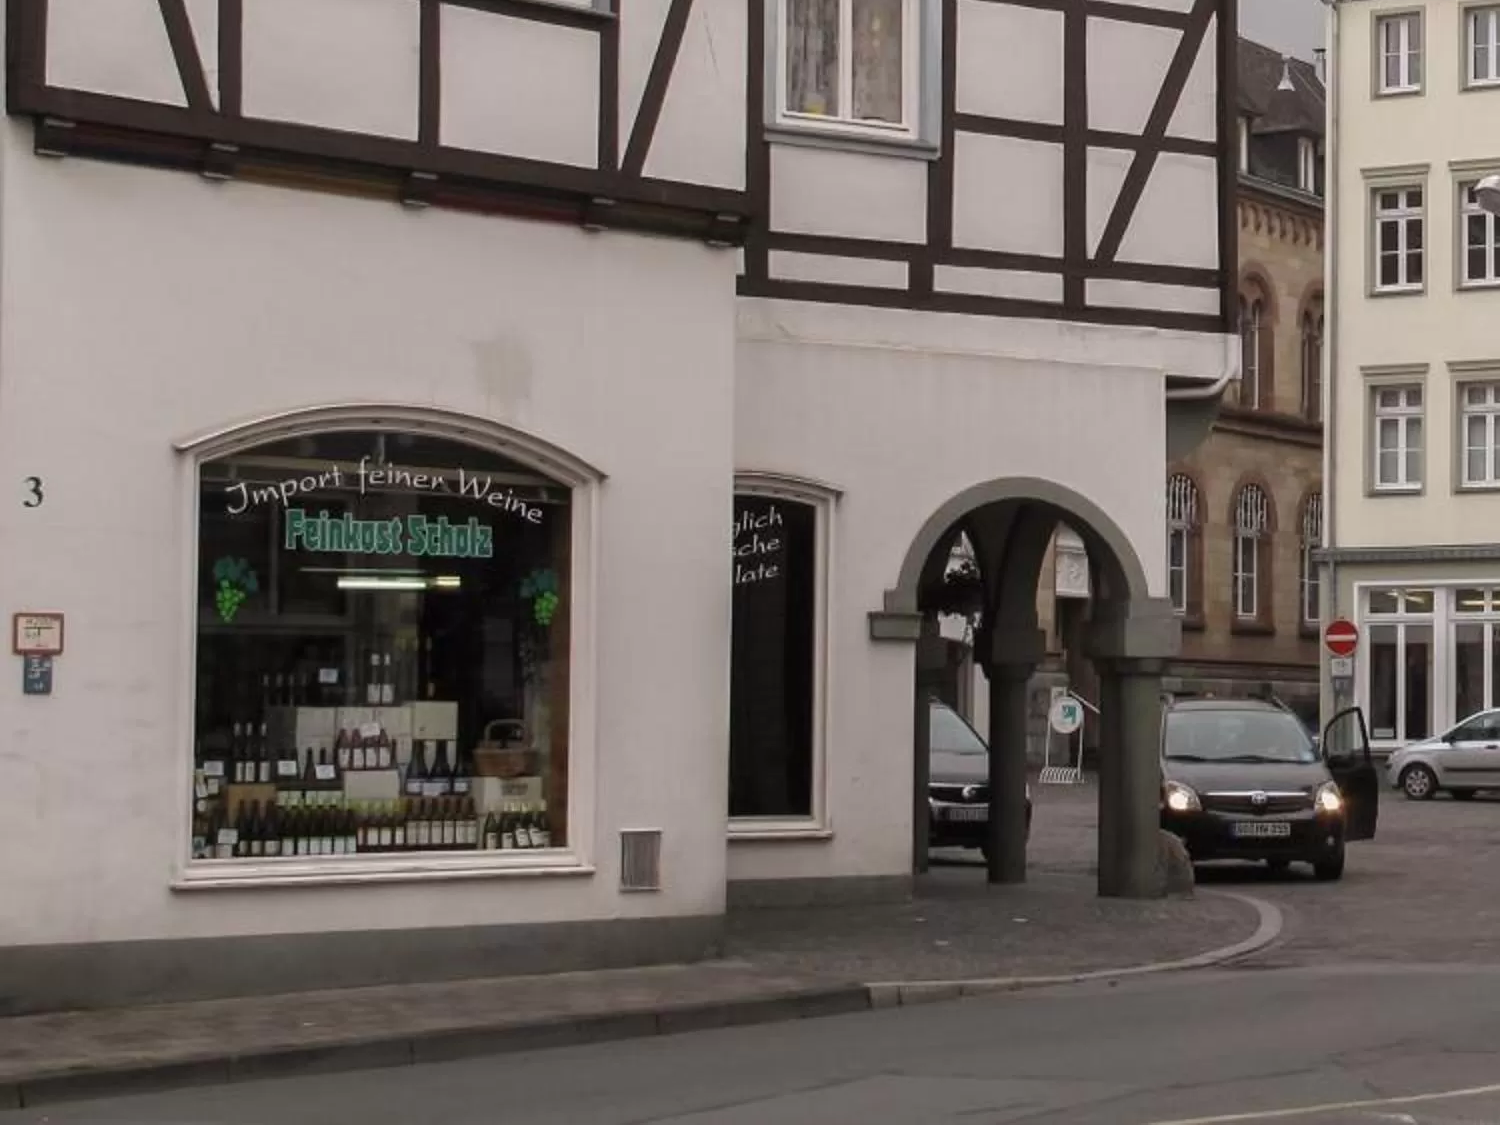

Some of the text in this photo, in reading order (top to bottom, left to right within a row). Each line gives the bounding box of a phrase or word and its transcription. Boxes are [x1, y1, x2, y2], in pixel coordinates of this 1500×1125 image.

[23, 476, 44, 508] 3
[357, 455, 444, 494] feiner
[458, 468, 544, 525] Weine
[285, 508, 494, 558] Feinkost Scholz
